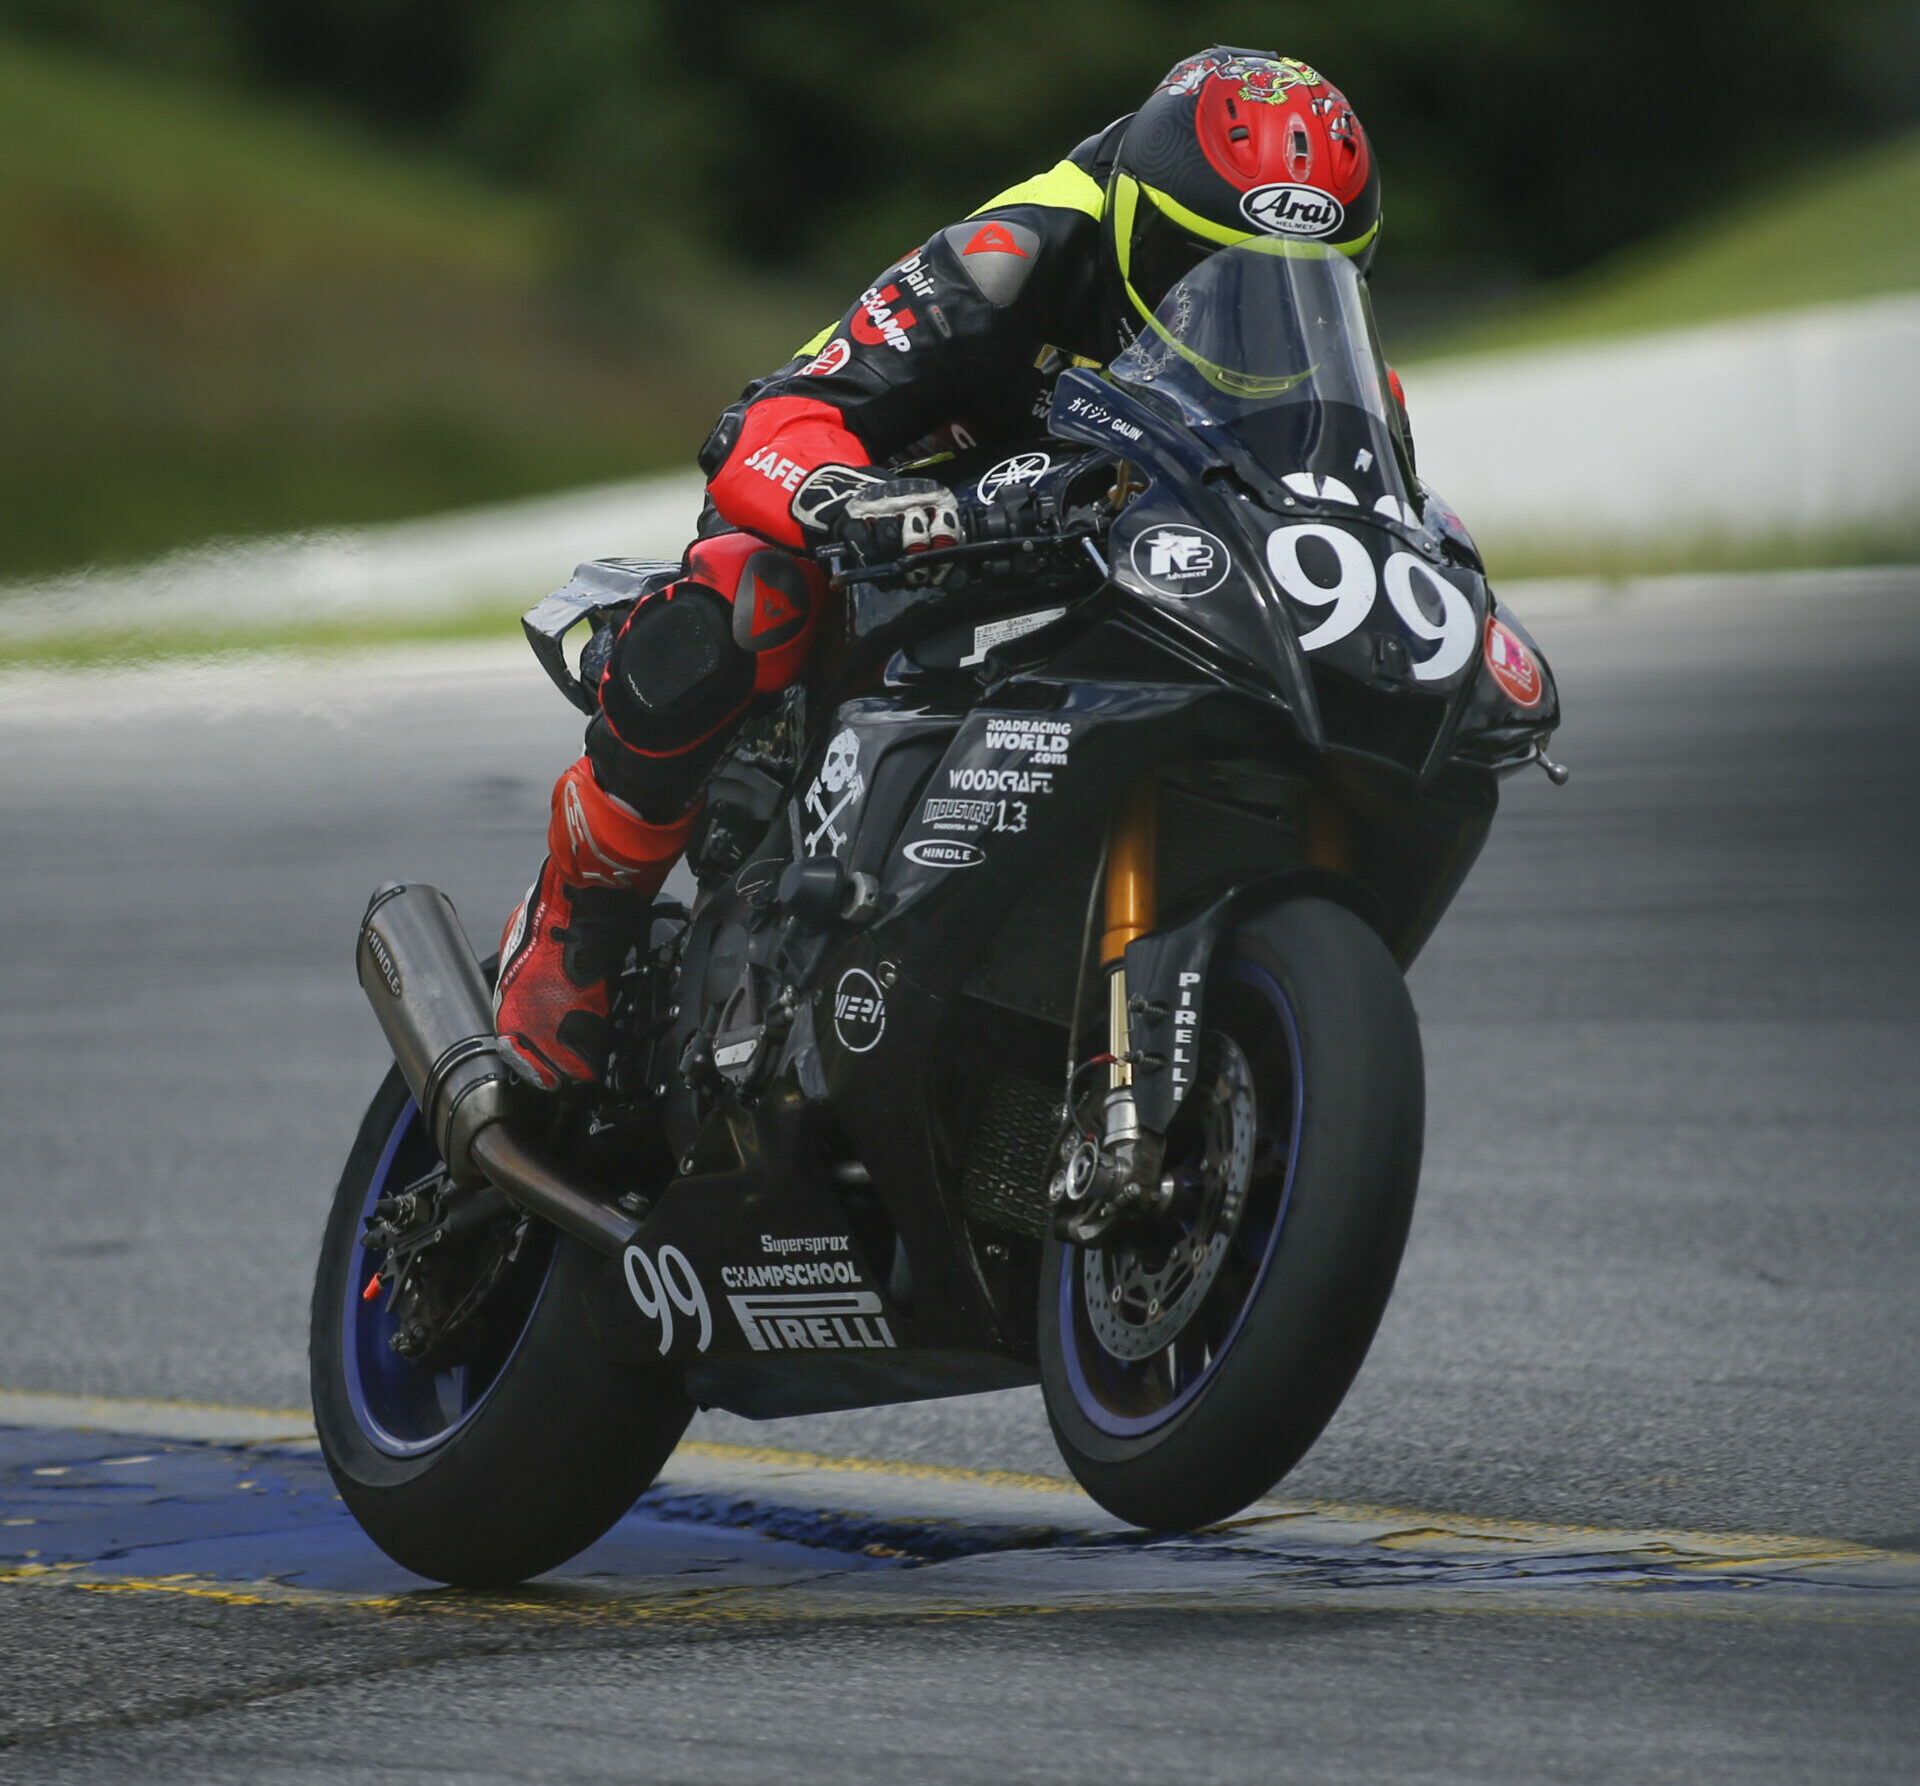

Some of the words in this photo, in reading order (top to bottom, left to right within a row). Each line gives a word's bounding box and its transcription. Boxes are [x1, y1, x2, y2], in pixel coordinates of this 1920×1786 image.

[1249, 190, 1333, 225] Arai
[860, 287, 911, 352] CHAMP
[743, 446, 808, 492] SAFE
[1266, 523, 1477, 681] 99
[985, 732, 1070, 752] WORLD
[986, 719, 1072, 735] ROADRACING
[1029, 751, 1068, 766] .com
[949, 769, 1053, 794] WOODCRAFT
[922, 799, 996, 826] INDUSTRY
[992, 799, 1028, 834] 13
[921, 847, 972, 861] HINDLE
[369, 933, 399, 993] HINDLE
[1171, 972, 1201, 1101] PIRELLI
[760, 1234, 849, 1256] Supersprox
[721, 1261, 862, 1288] CHAMPSCHOOL
[623, 1245, 712, 1356] 99
[726, 1291, 898, 1350] PIRELLI
